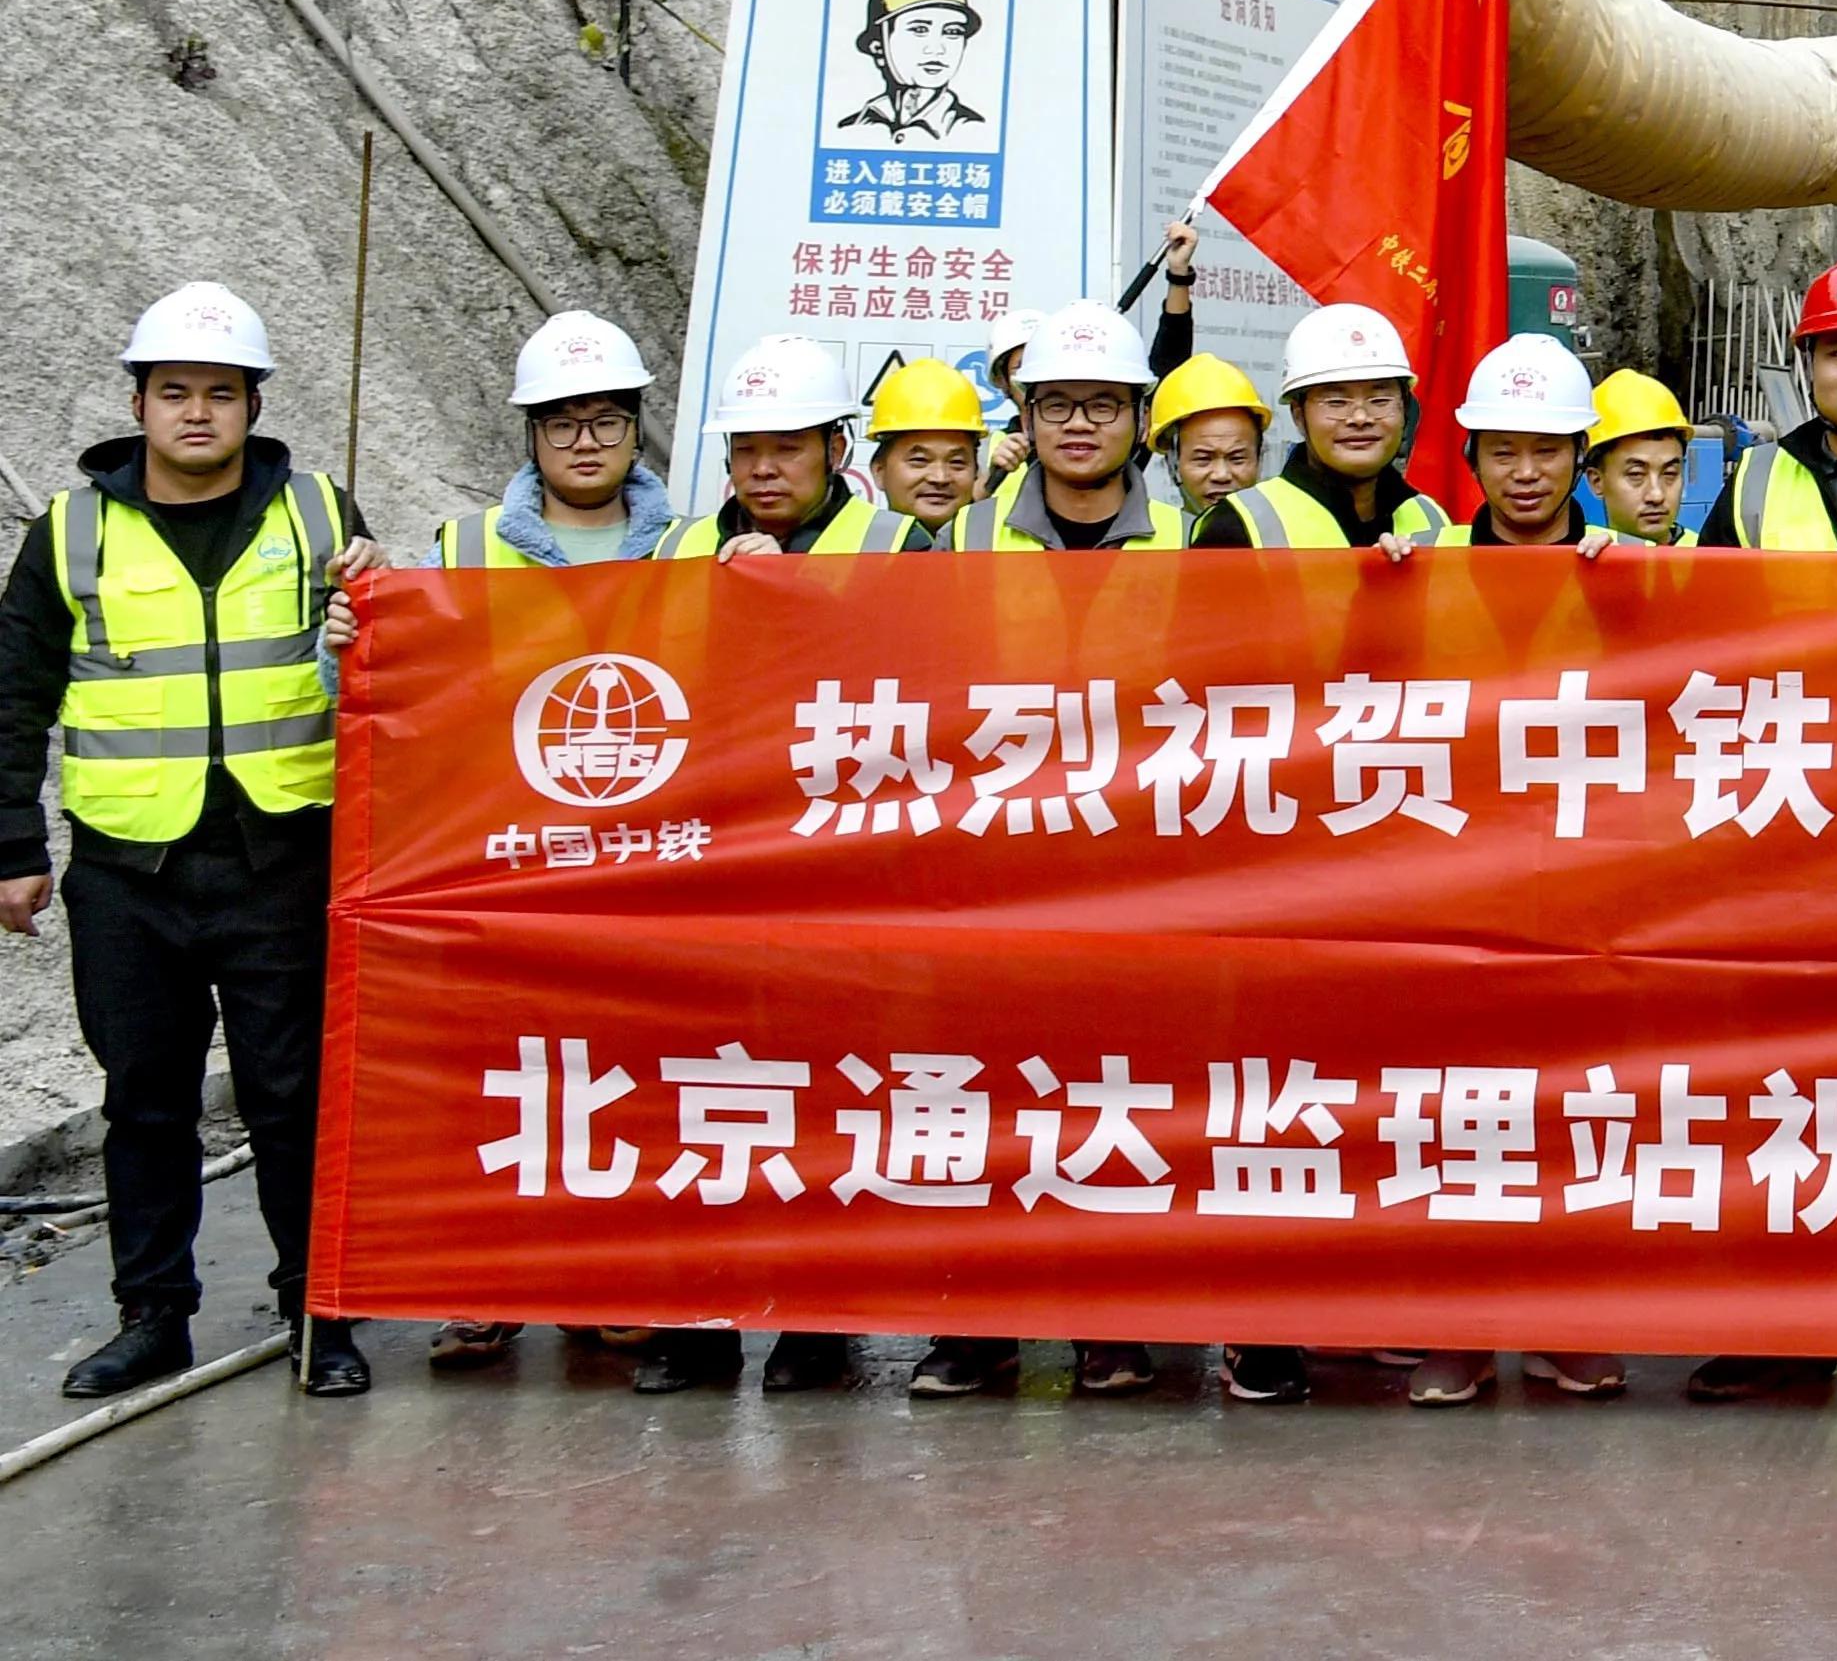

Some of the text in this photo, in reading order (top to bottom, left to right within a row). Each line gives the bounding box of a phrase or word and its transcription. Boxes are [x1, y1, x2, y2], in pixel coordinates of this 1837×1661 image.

[824, 158, 991, 189] 进入施工现场
[823, 189, 989, 220] 必须戴安全帽
[792, 241, 1015, 282] 保护生命安全
[789, 282, 1010, 322] 提高应急意识
[486, 818, 712, 870] 中国中铁
